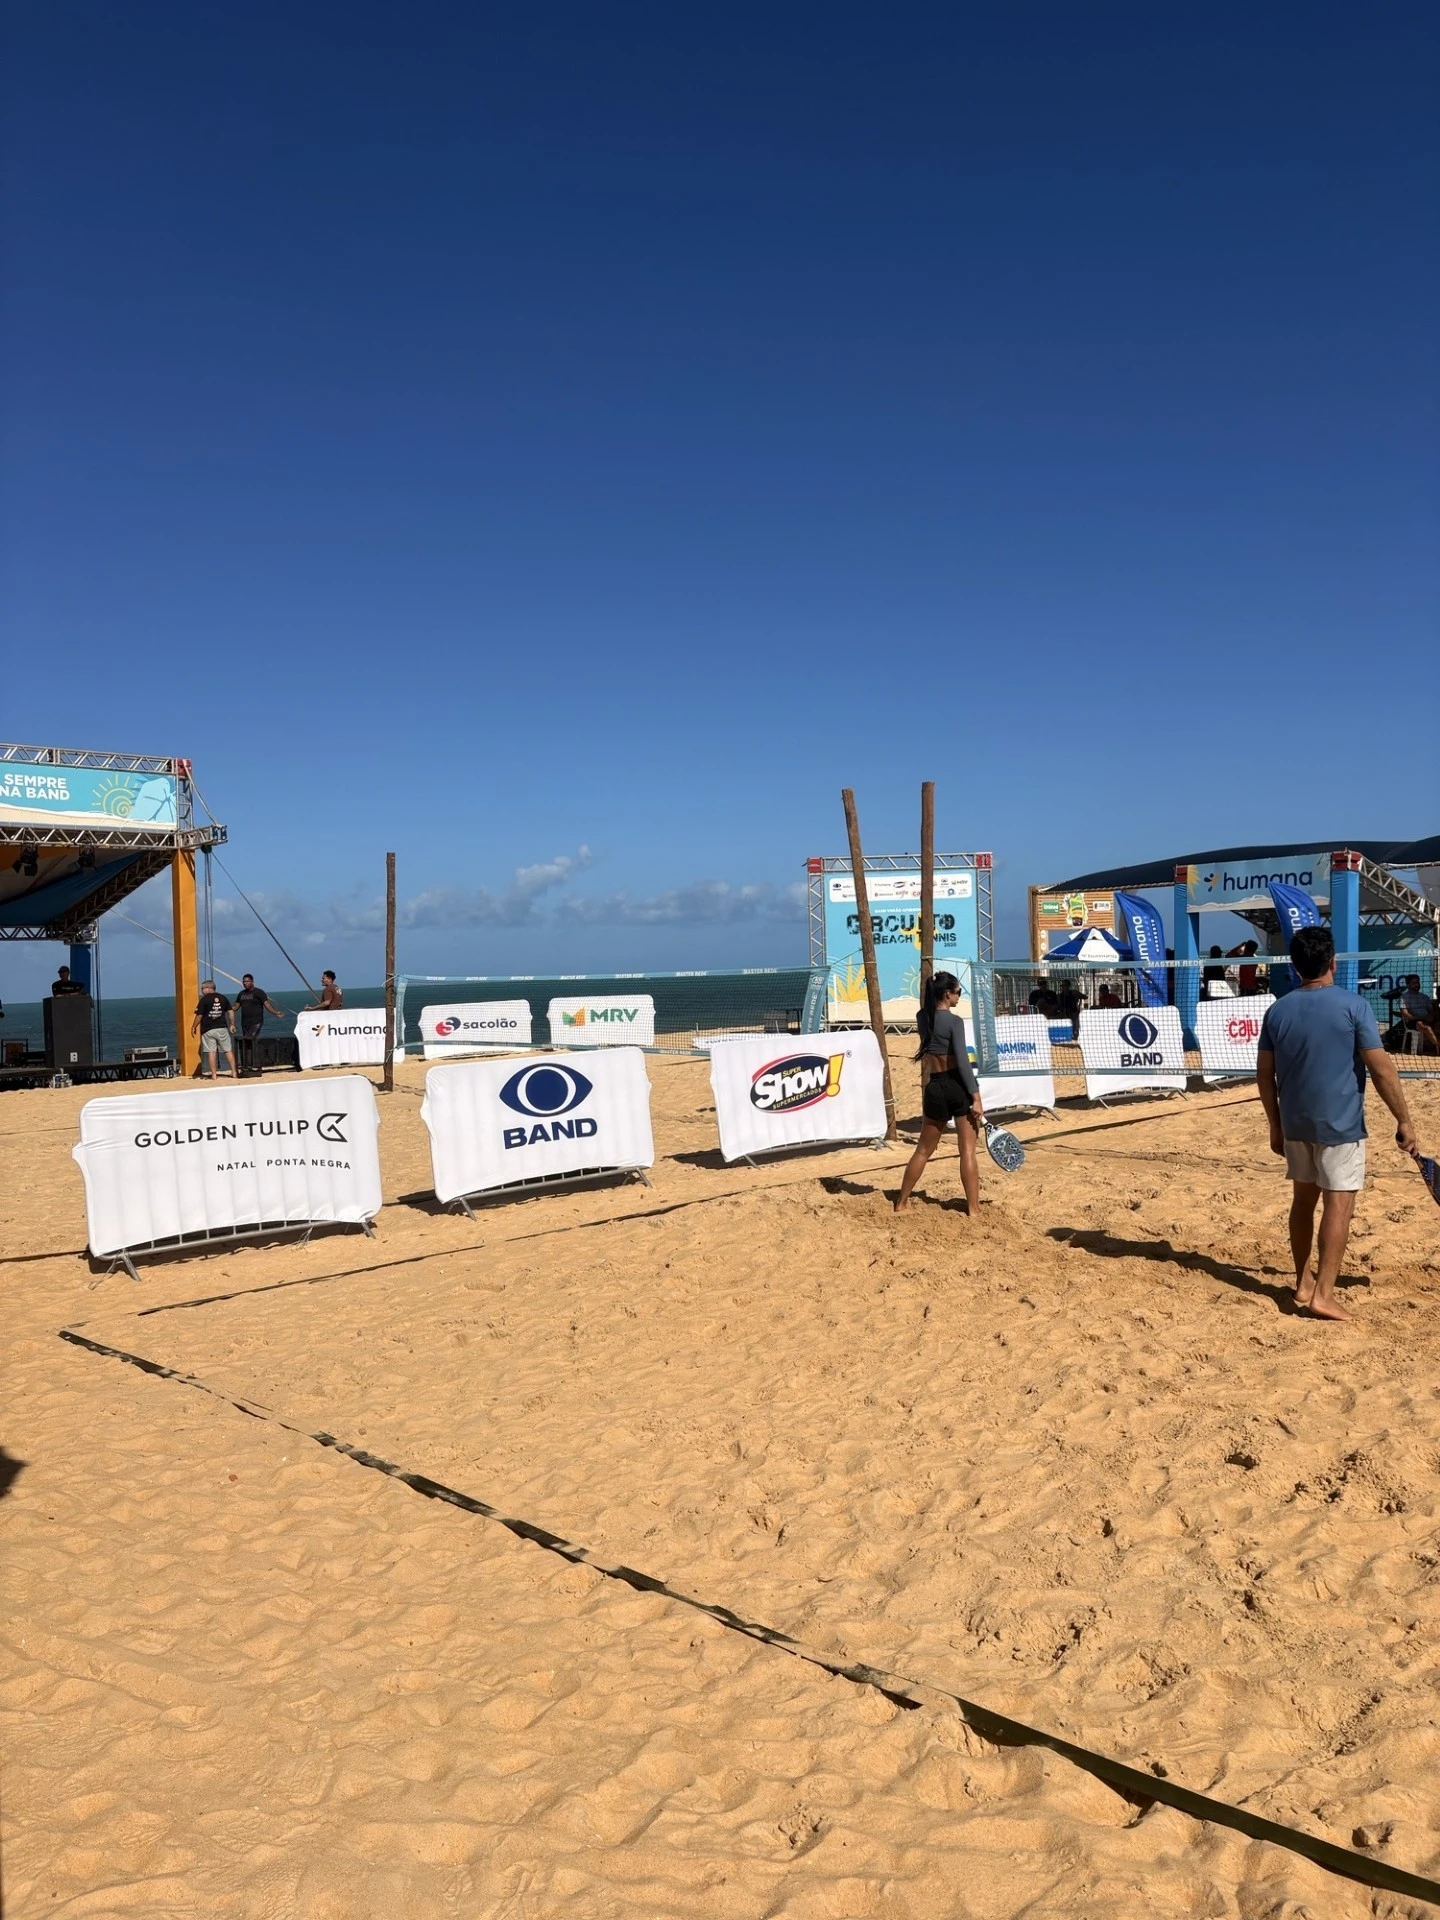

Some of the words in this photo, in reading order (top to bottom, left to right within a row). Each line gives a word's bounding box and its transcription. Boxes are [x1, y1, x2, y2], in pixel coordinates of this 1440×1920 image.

[4, 773, 67, 789] SEMPRE
[0, 785, 22, 798] NA
[26, 787, 70, 800] BAND
[872, 932, 913, 945] BEACH
[916, 931, 957, 943] TNNIS
[1148, 960, 1180, 968] MASTER
[590, 1008, 640, 1023] MRV
[463, 1018, 518, 1030] sacolão
[1228, 1014, 1259, 1042] caju
[979, 1023, 990, 1061] MASTER
[1120, 1053, 1163, 1067] BAND
[772, 1088, 822, 1110] SUPERMERCADOS
[134, 1124, 237, 1148] GOLDEN
[244, 1119, 310, 1138] TULIP
[503, 1117, 598, 1150] BAND
[217, 1161, 256, 1172] NATAL
[266, 1158, 306, 1167] PONTA
[311, 1158, 350, 1170] NEGRA
